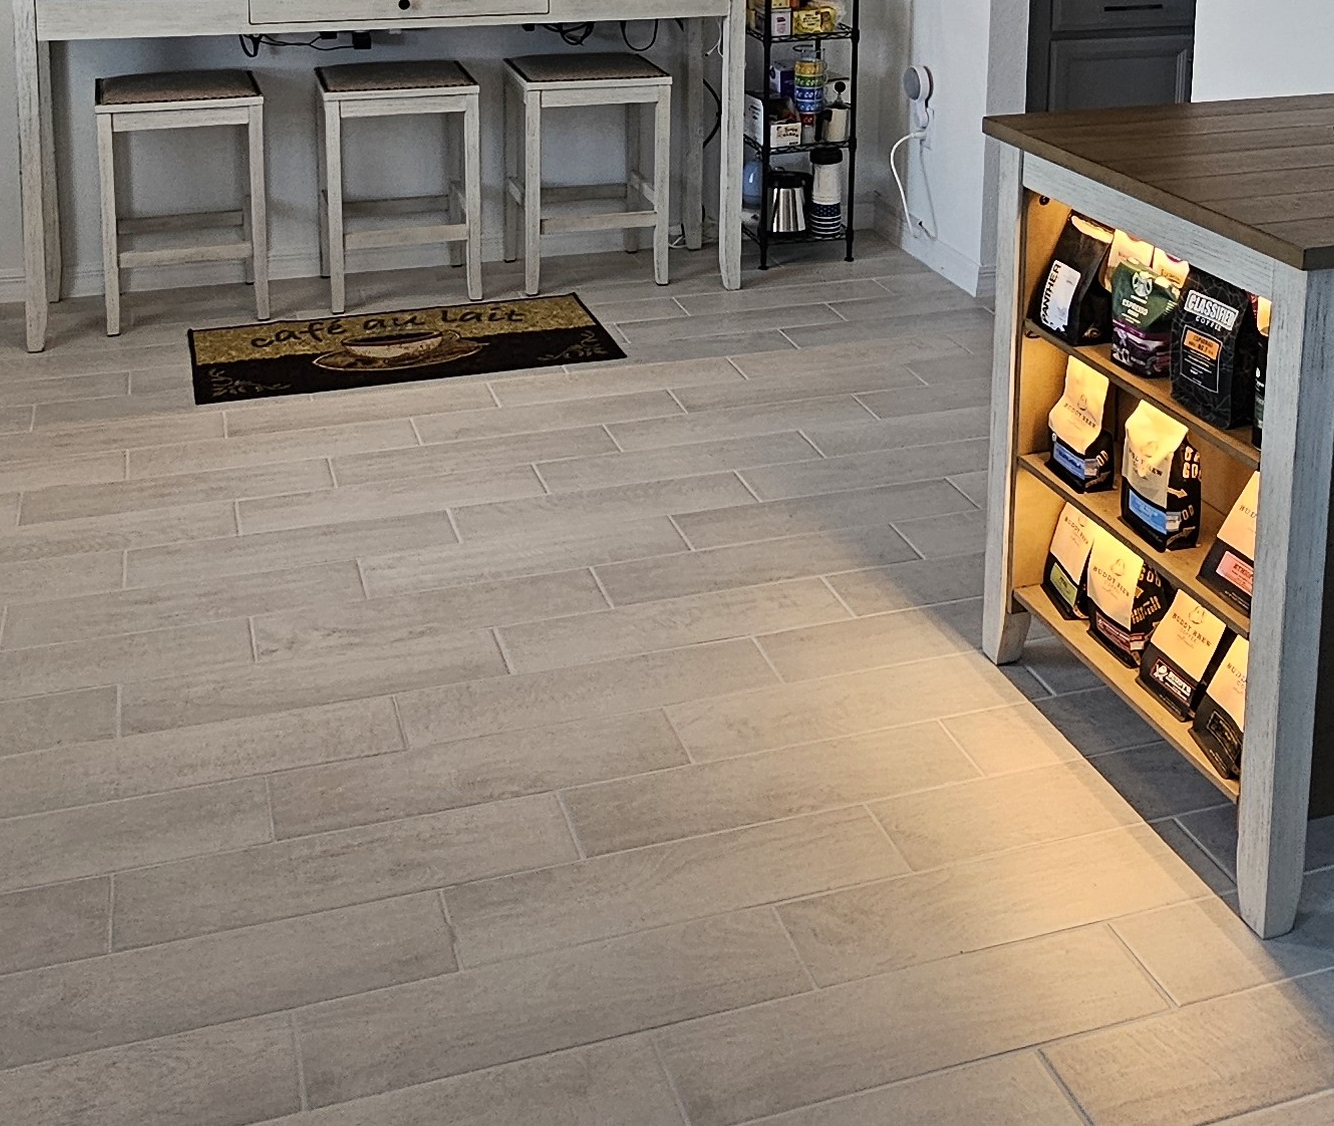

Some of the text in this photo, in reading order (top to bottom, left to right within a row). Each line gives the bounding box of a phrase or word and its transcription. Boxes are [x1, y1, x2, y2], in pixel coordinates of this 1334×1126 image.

[1042, 263, 1062, 324] PANTHER
[1188, 294, 1234, 327] CLASSIFIED
[251, 321, 347, 349] café
[441, 309, 523, 324] lait
